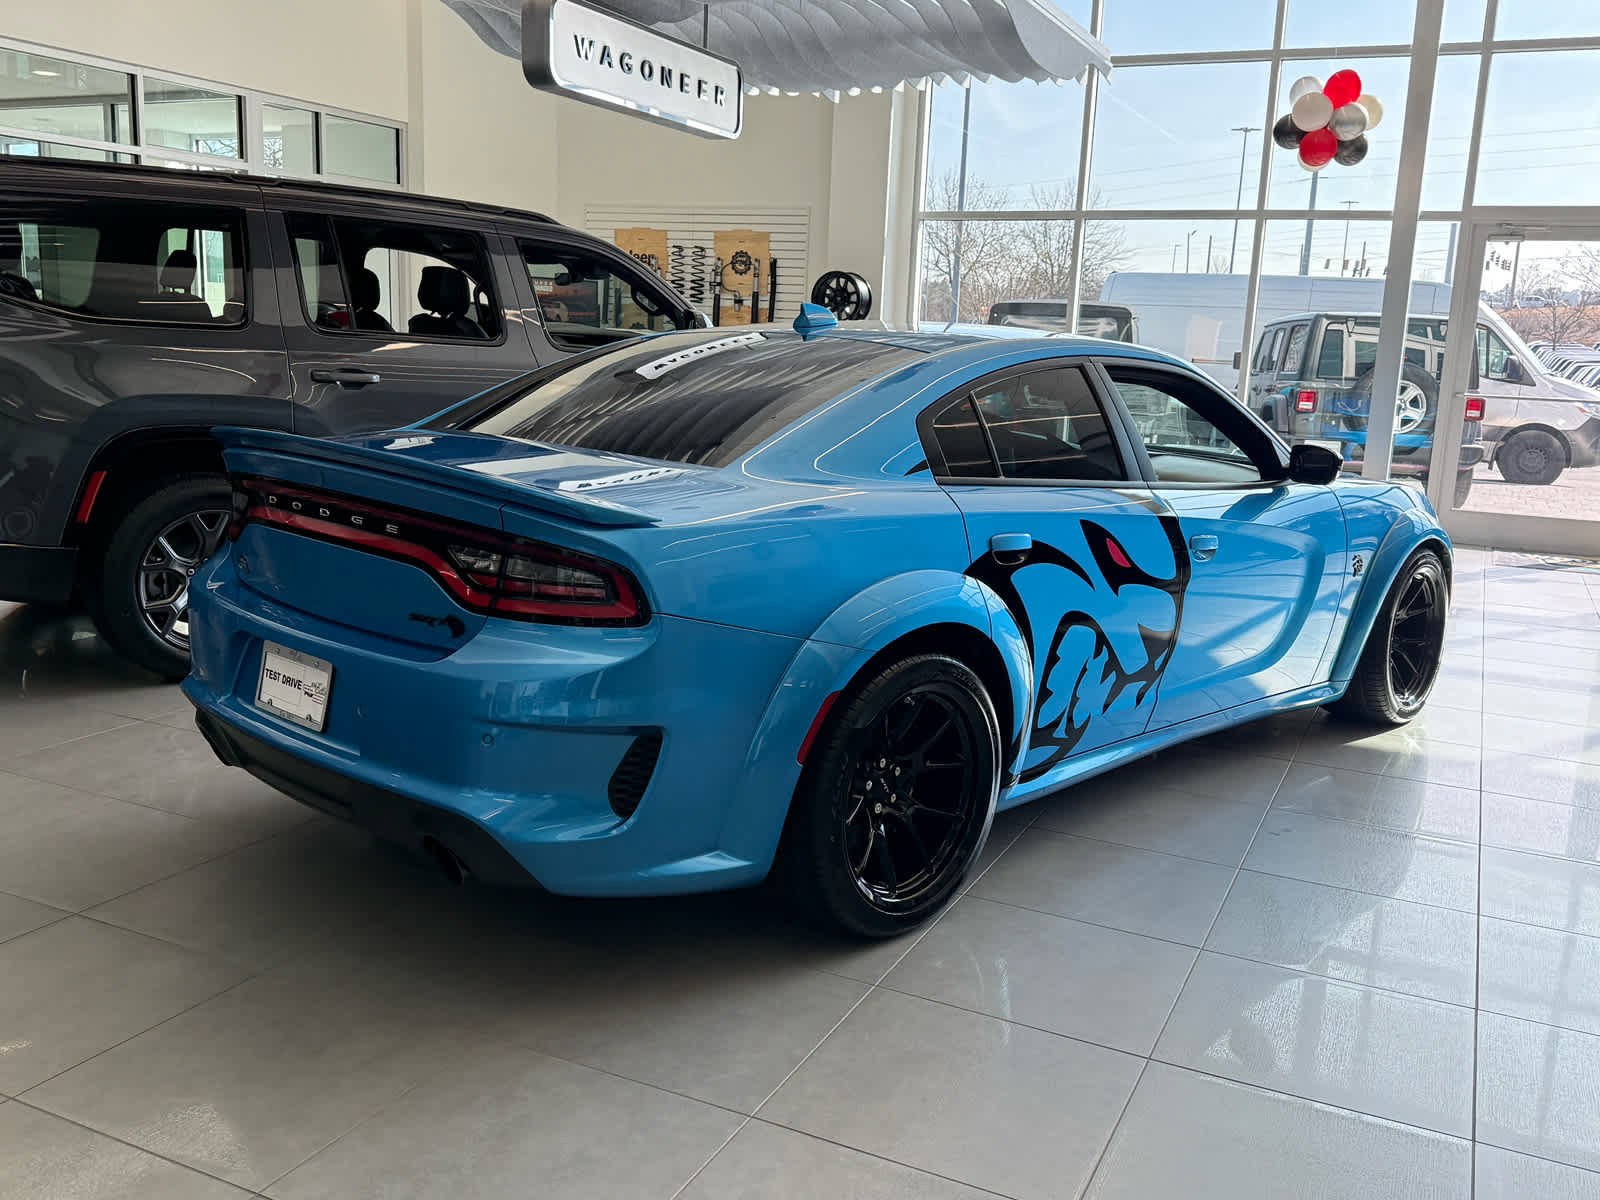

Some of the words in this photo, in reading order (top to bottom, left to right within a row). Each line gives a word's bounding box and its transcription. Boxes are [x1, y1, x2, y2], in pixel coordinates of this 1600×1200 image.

[573, 33, 727, 107] WAGONEER
[268, 495, 400, 534] DODGE
[265, 668, 281, 682] TEST
[281, 674, 303, 691] DRIVE
